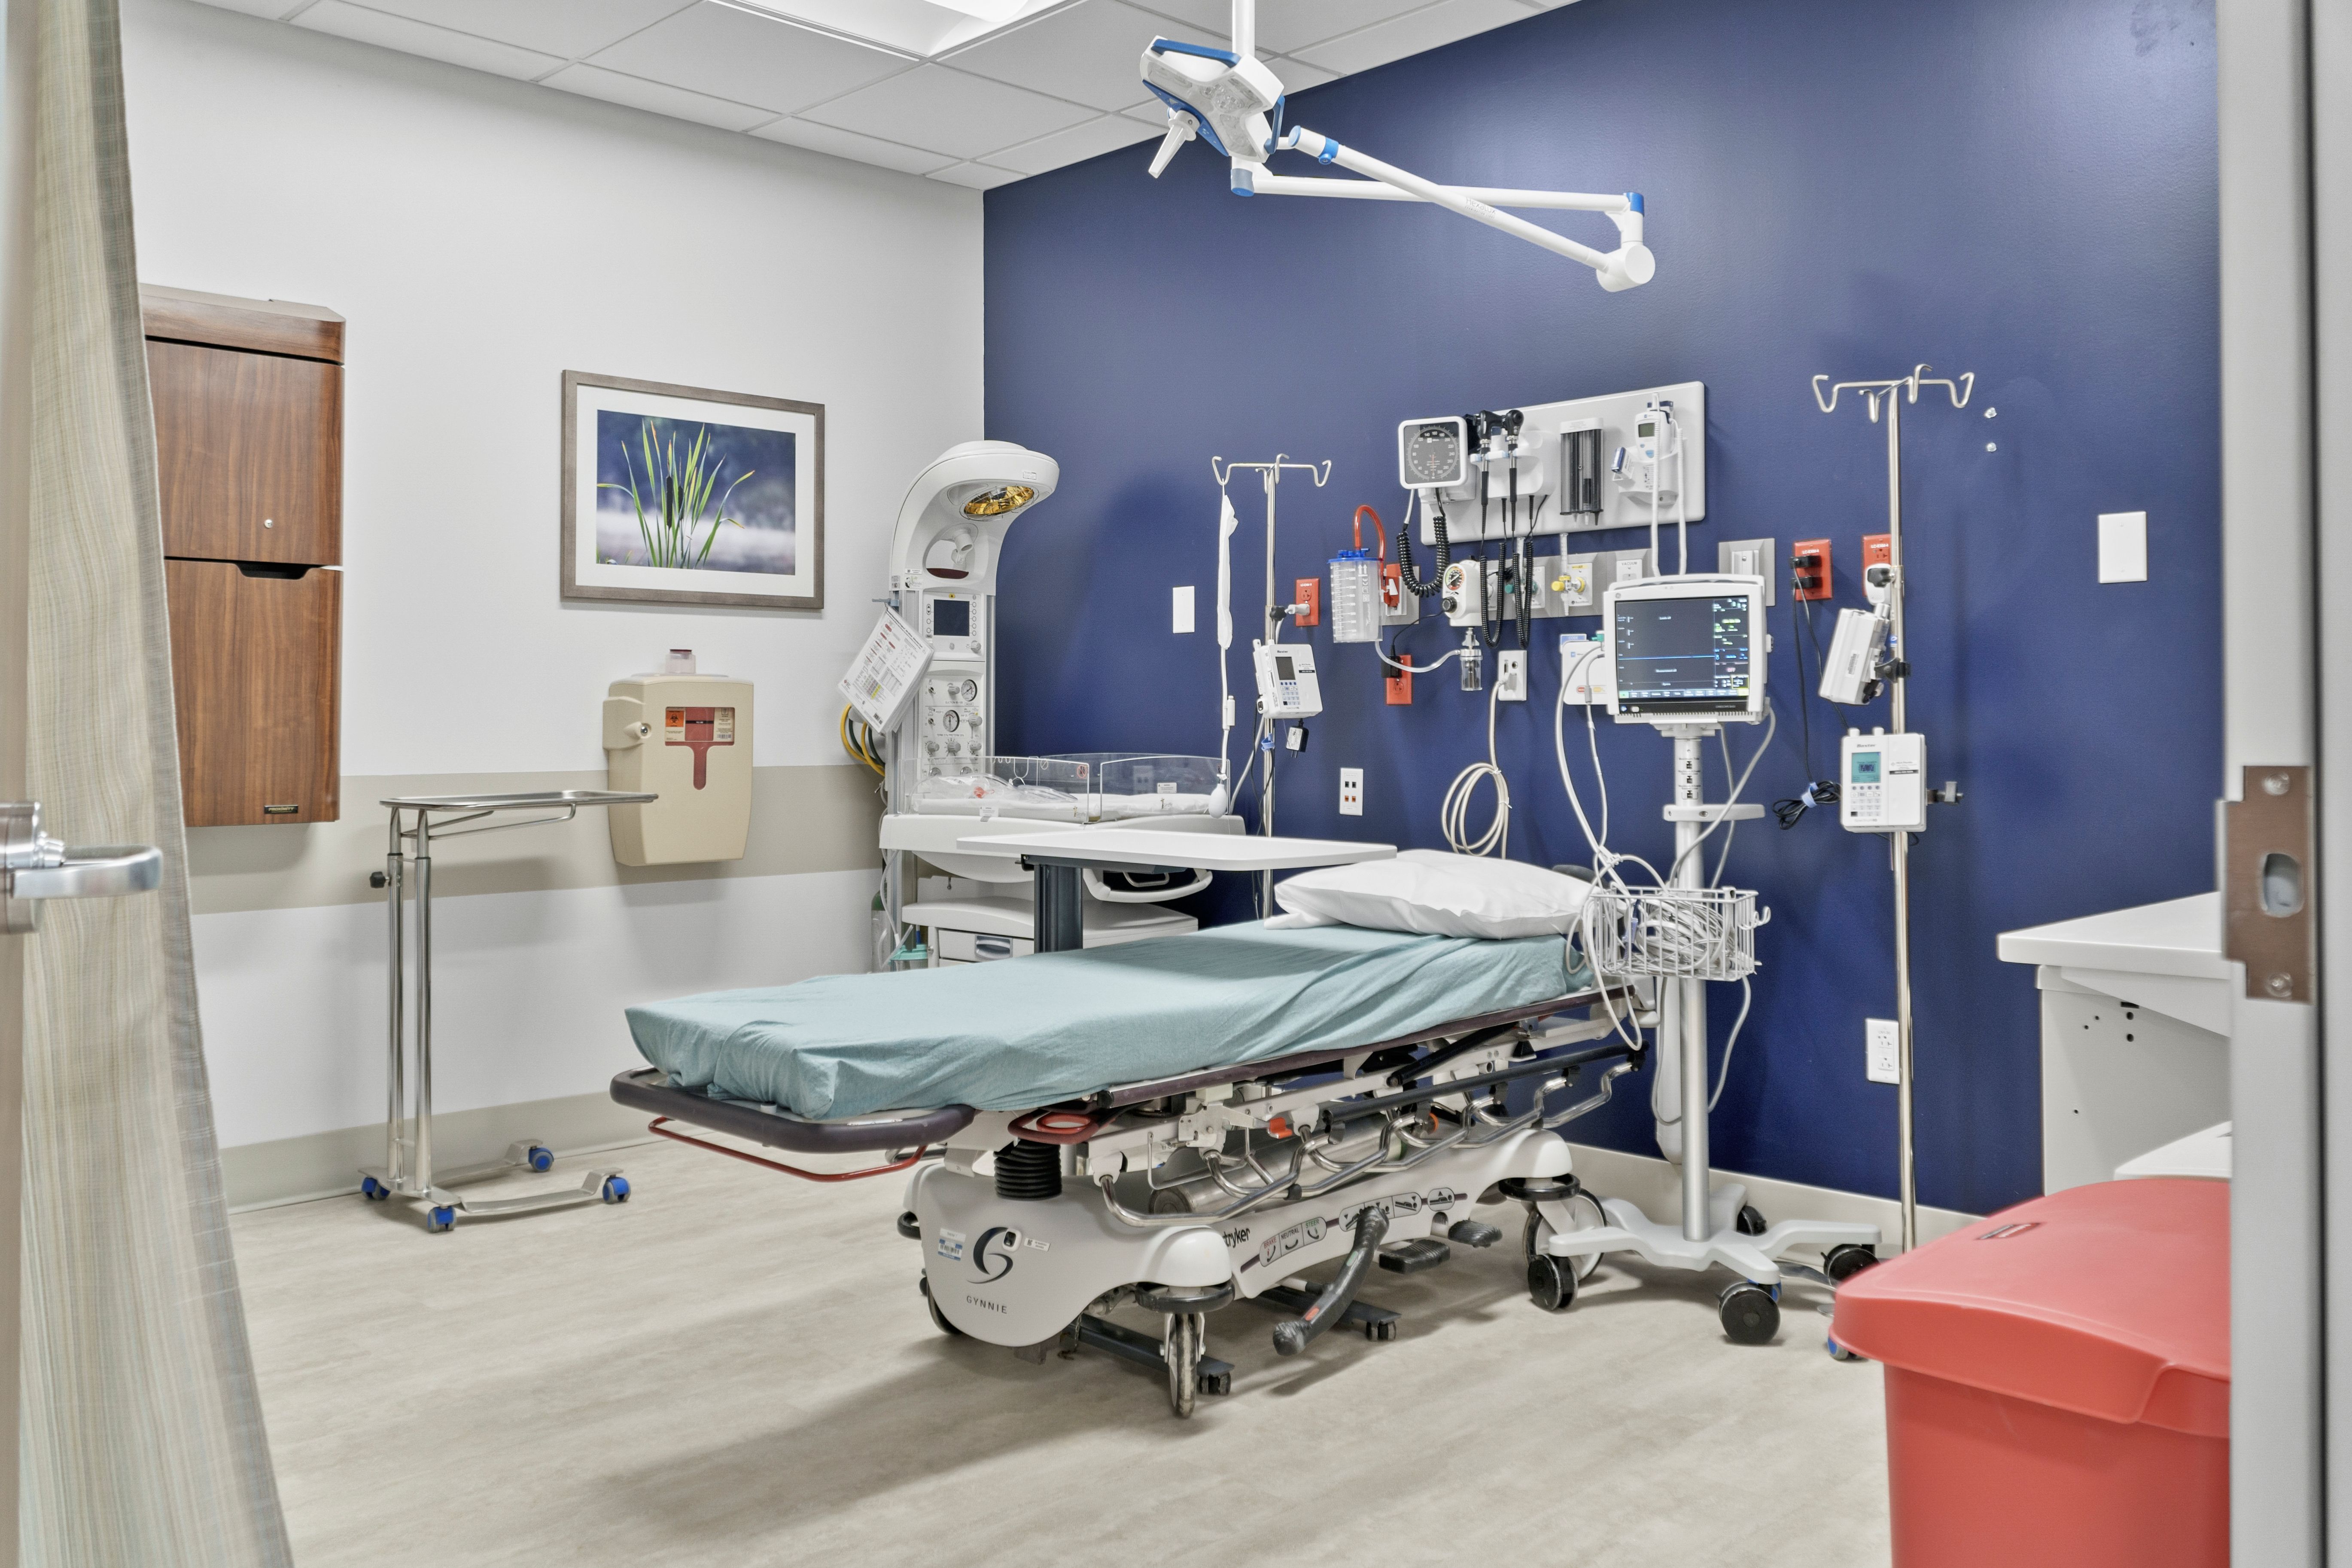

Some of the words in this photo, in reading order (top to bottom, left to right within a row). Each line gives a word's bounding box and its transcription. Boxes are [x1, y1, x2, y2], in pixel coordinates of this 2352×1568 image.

[1305, 1219, 1320, 1229] STEER
[1223, 1228, 1250, 1248] tryker
[1281, 1227, 1299, 1240] NEUTRAL
[1264, 1237, 1277, 1249] BRAKE
[967, 1295, 1007, 1314] GYNNIE
